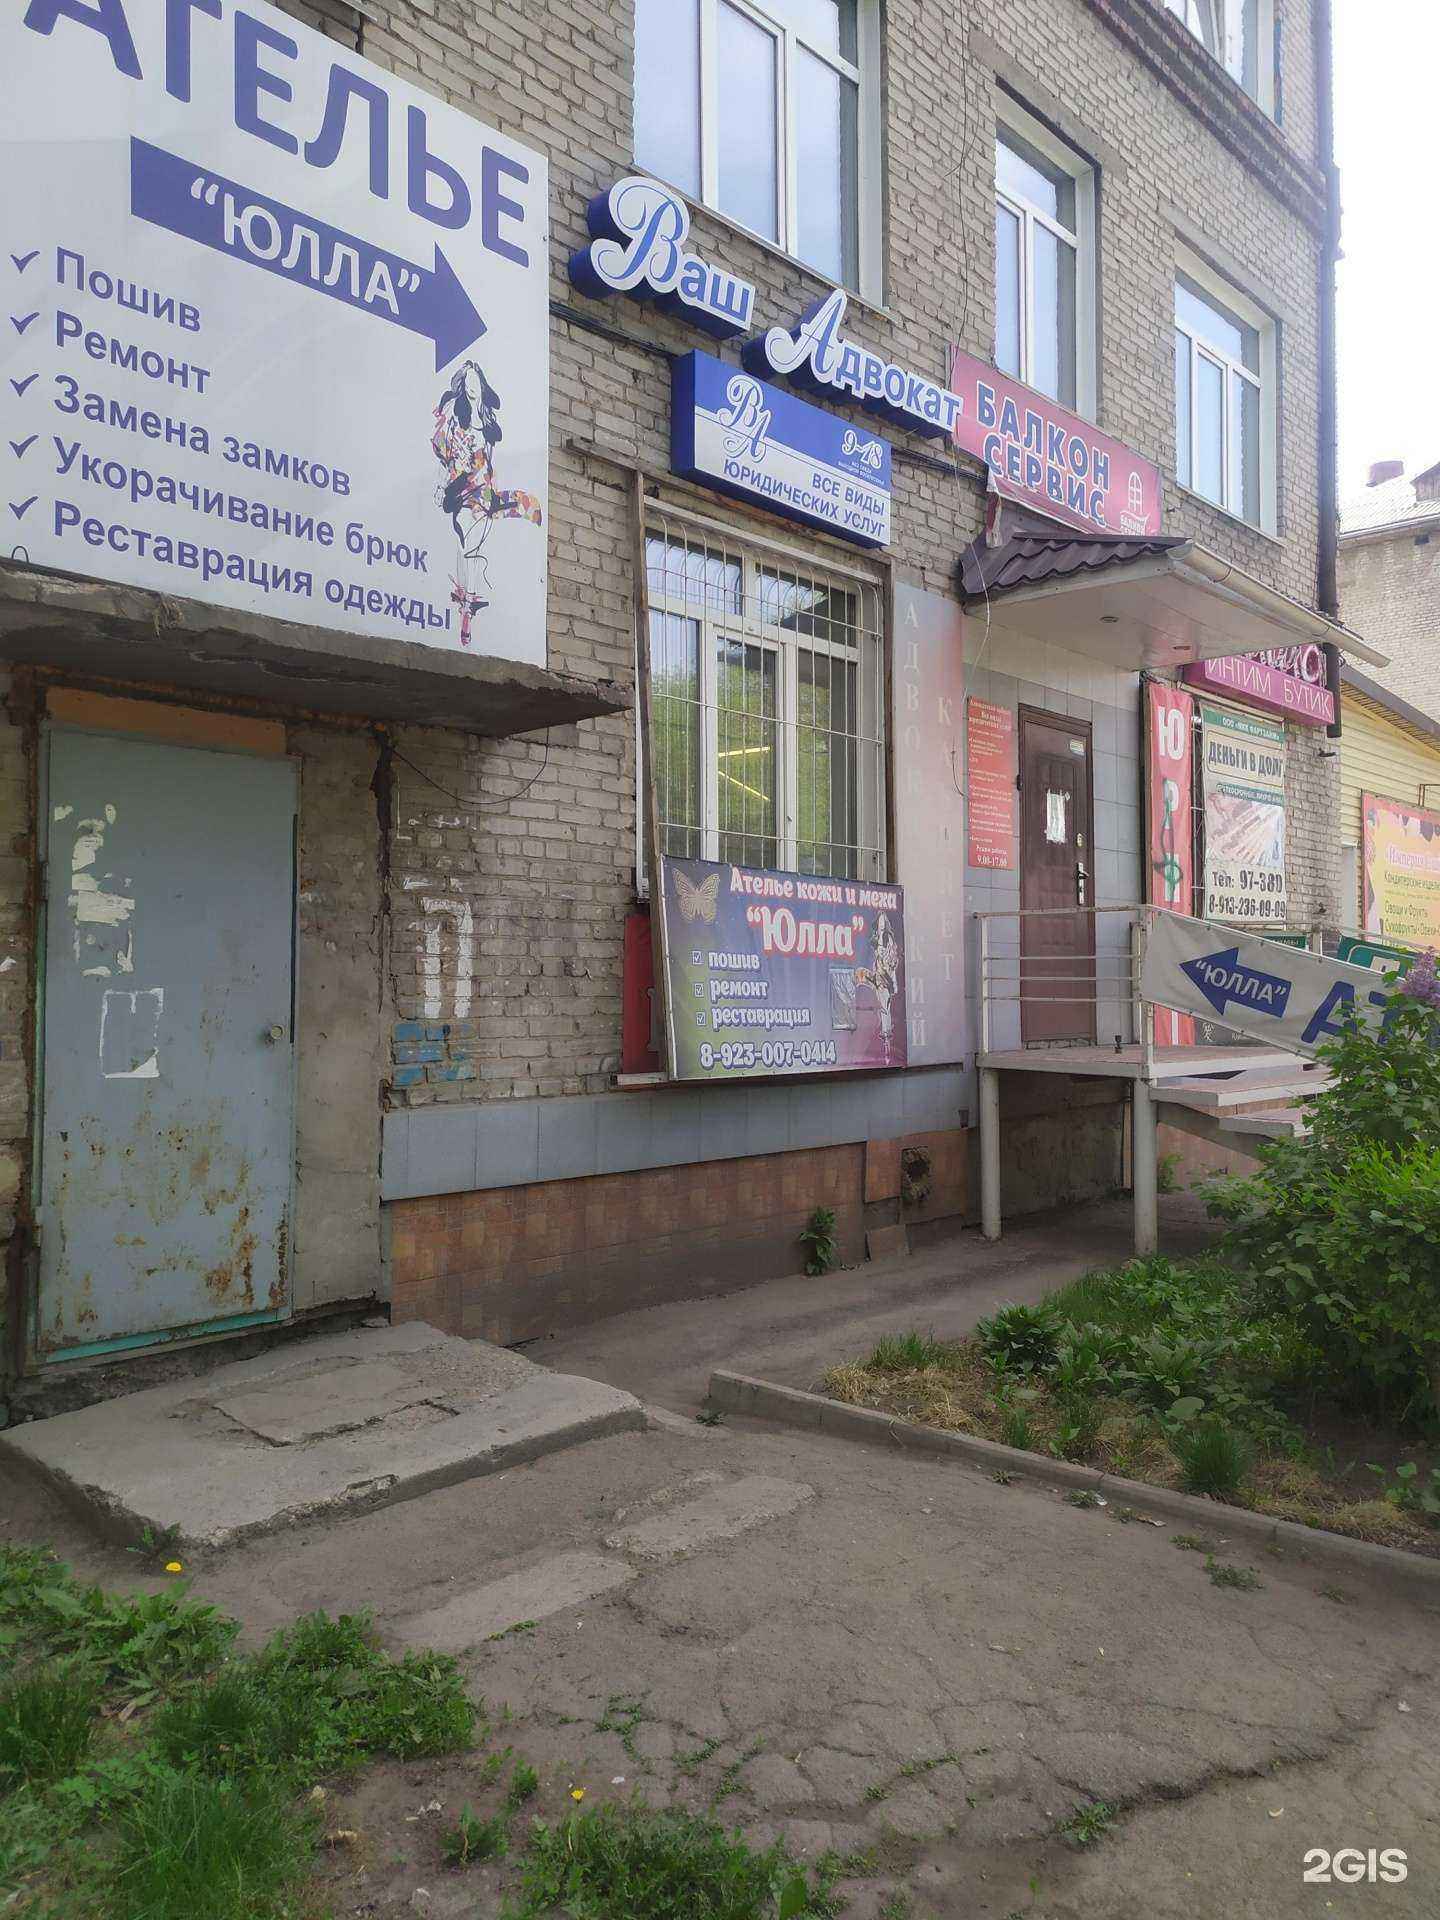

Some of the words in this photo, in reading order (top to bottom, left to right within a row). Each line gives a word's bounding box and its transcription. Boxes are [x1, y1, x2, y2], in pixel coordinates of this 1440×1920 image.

[190, 177, 420, 315] “ЮЛЛА”
[590, 177, 755, 331] Ваш
[56, 246, 201, 333] Пошив
[56, 310, 211, 395] Ремонт
[765, 288, 964, 433] Адвокат
[54, 375, 210, 455] Замена
[222, 434, 351, 497] замков
[976, 380, 1111, 493] БАЛКОН
[53, 436, 335, 548] Укорачивание
[345, 522, 429, 573] брюк
[723, 458, 840, 520] ЮРИДИЧЕСКИХ
[843, 508, 885, 537] УСЛУГ
[812, 473, 841, 498] ВСЕ
[845, 490, 885, 517] ВИДЫ
[984, 432, 1107, 528] СЕРВИС
[54, 500, 314, 597] Реставрация
[324, 578, 451, 631] одежды
[1208, 657, 1272, 697] ИНТИМ
[1283, 679, 1331, 719] БУТИК
[1209, 741, 1248, 771] ДЕНЬГИ
[1250, 752, 1256, 772] В
[730, 866, 794, 898] Ателье
[797, 881, 843, 903] кожи
[845, 887, 856, 906] и
[859, 890, 897, 910] меха
[1209, 894, 1286, 919] 8-913-236-09-09
[1212, 871, 1235, 889] Тел:
[708, 951, 761, 970] пошив
[746, 905, 865, 957] “Юлла”
[709, 978, 769, 1003] ремонт
[1195, 960, 1287, 1005] “ЮЛЛА”
[711, 1006, 811, 1032] реставрация
[699, 1039, 838, 1070] 8-923-007-0414
